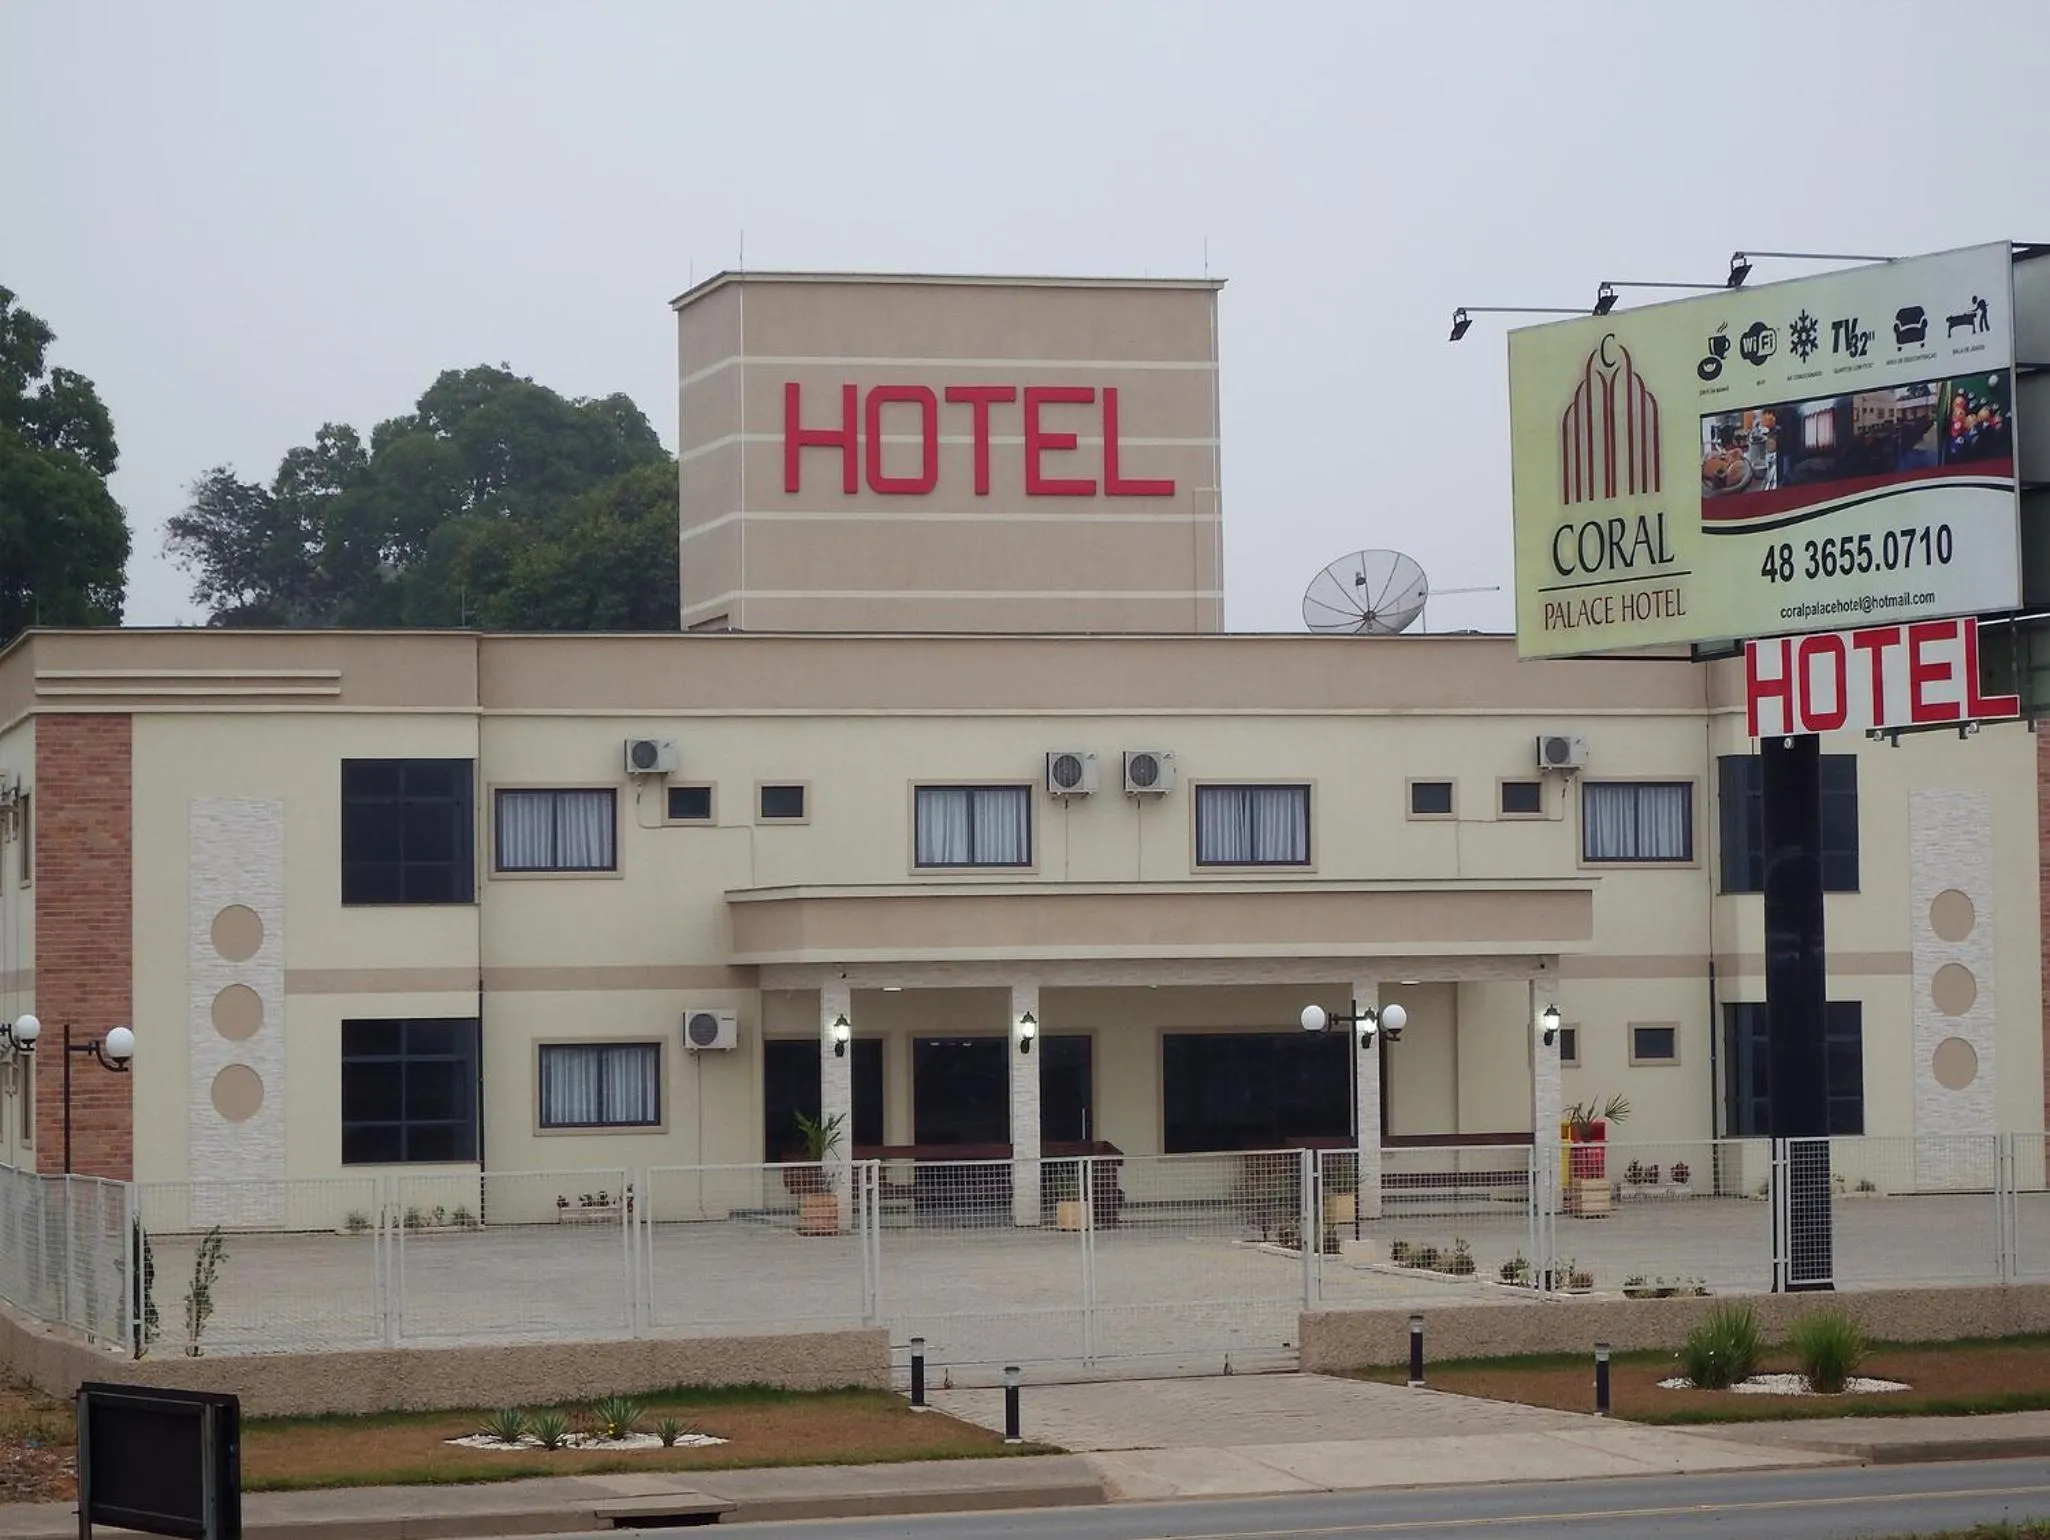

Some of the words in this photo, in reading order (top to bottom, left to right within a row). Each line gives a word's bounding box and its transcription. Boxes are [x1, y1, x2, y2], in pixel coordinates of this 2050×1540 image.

[1600, 333, 1617, 368] C
[785, 382, 1175, 496] HOTEL
[1553, 512, 1675, 576] CORAL
[1761, 543, 1795, 583] 48
[1804, 524, 1953, 579] 3655.0710
[1545, 596, 1616, 631] PALACE
[1621, 588, 1687, 622] HOTEL
[1780, 591, 1936, 619] coralpalacehotel@hotmail.com
[1745, 617, 2019, 737] HOTEL
